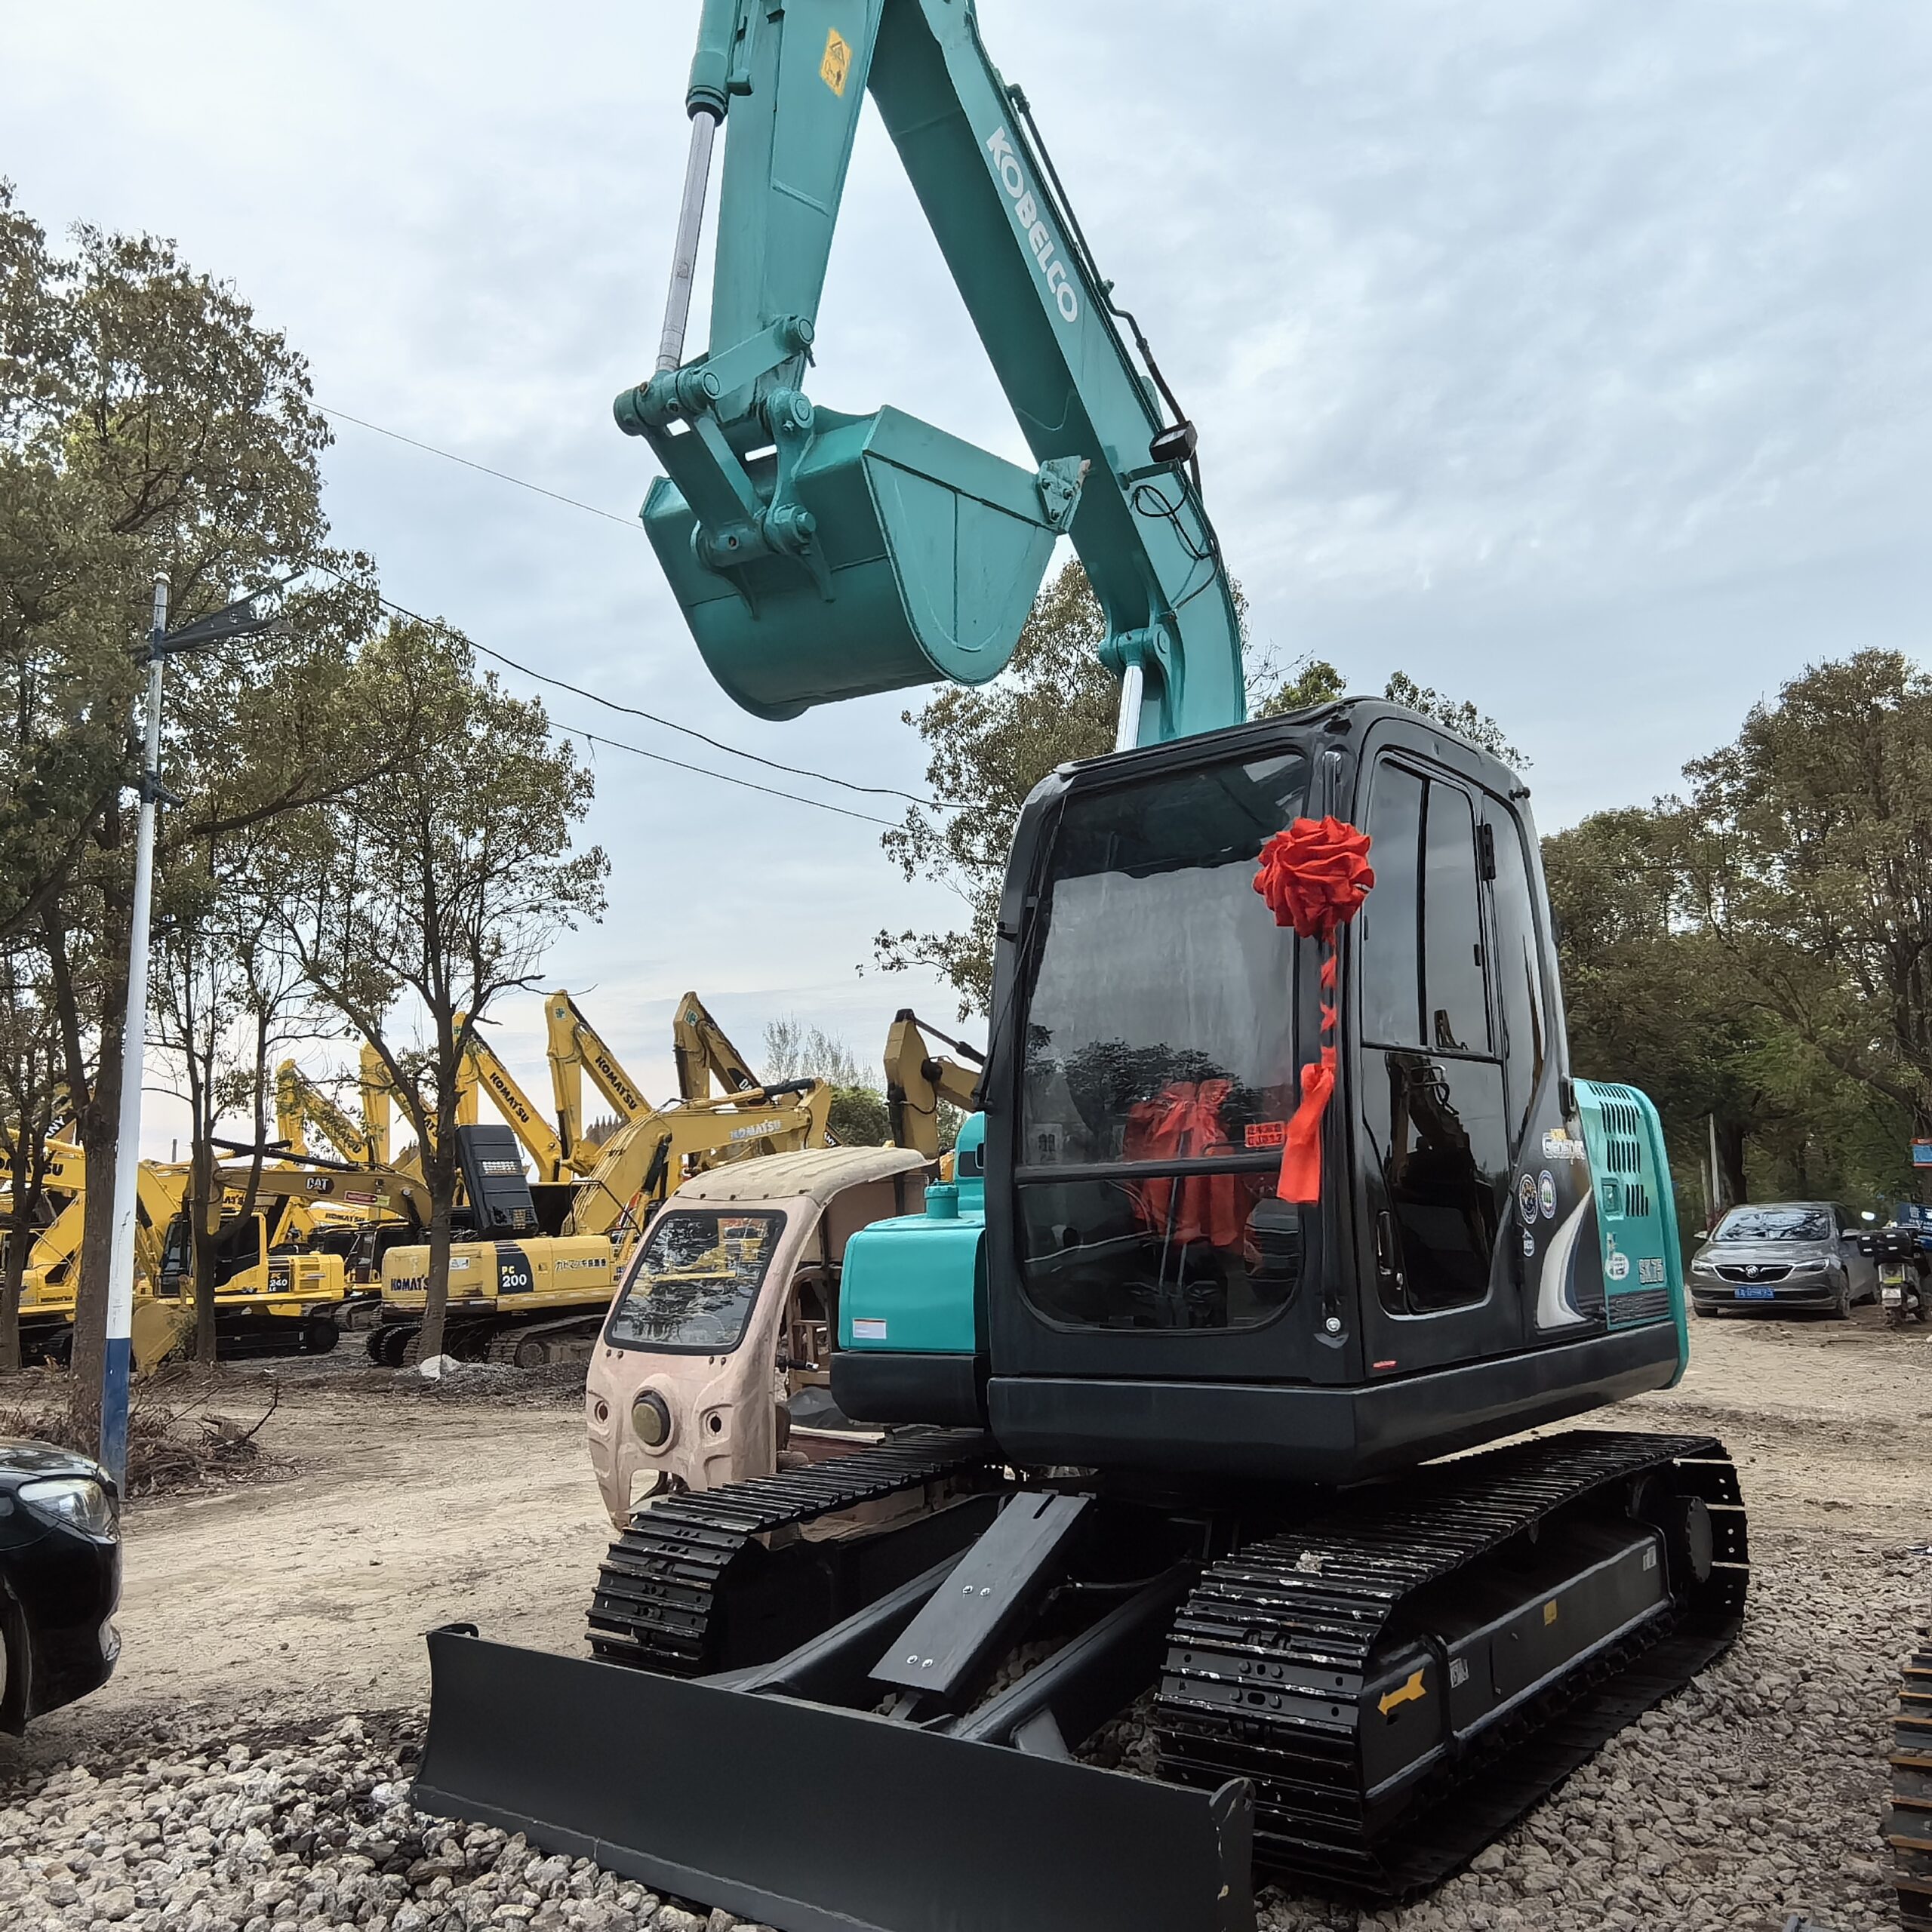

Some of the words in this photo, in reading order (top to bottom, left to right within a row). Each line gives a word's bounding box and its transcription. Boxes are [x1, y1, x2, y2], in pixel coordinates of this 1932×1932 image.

[985, 126, 1078, 324] KOBELCO
[595, 1056, 637, 1111] KOMATSU
[489, 1072, 530, 1124] KOMATSU
[45, 1115, 66, 1140] ANY
[730, 1120, 781, 1140] KOMATSU
[306, 1177, 330, 1191] CAT
[501, 1266, 515, 1275] PC
[502, 1273, 528, 1288] 200
[390, 1274, 429, 1292] KOMATS
